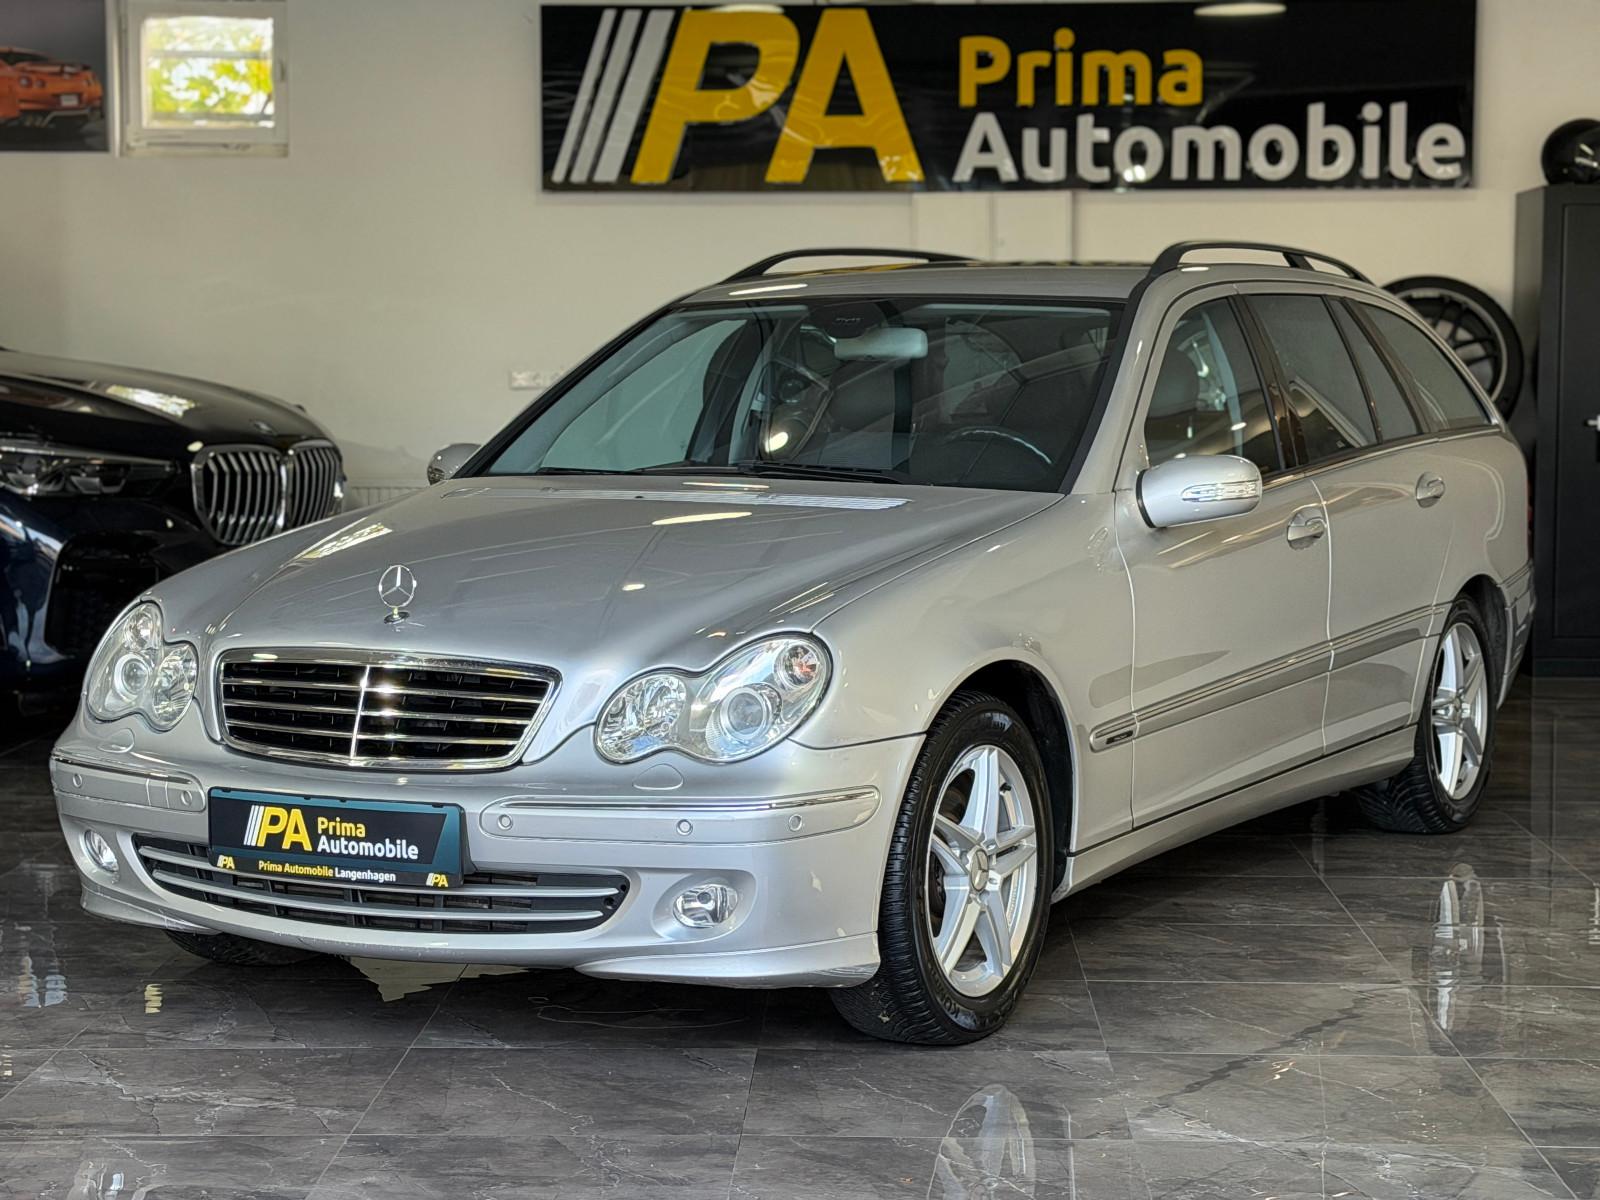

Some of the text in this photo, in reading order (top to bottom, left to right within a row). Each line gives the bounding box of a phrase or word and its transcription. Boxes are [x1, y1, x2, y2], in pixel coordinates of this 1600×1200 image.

[959, 28, 1204, 107] Prima
[630, 8, 925, 184] PA
[952, 101, 1466, 184] Automobile
[256, 806, 313, 852] PA
[317, 816, 366, 838] Prima
[317, 835, 419, 860] Automobile
[220, 855, 236, 870] PA
[258, 860, 396, 884] Prima Automobile Langenhagen
[431, 873, 449, 888] PA
